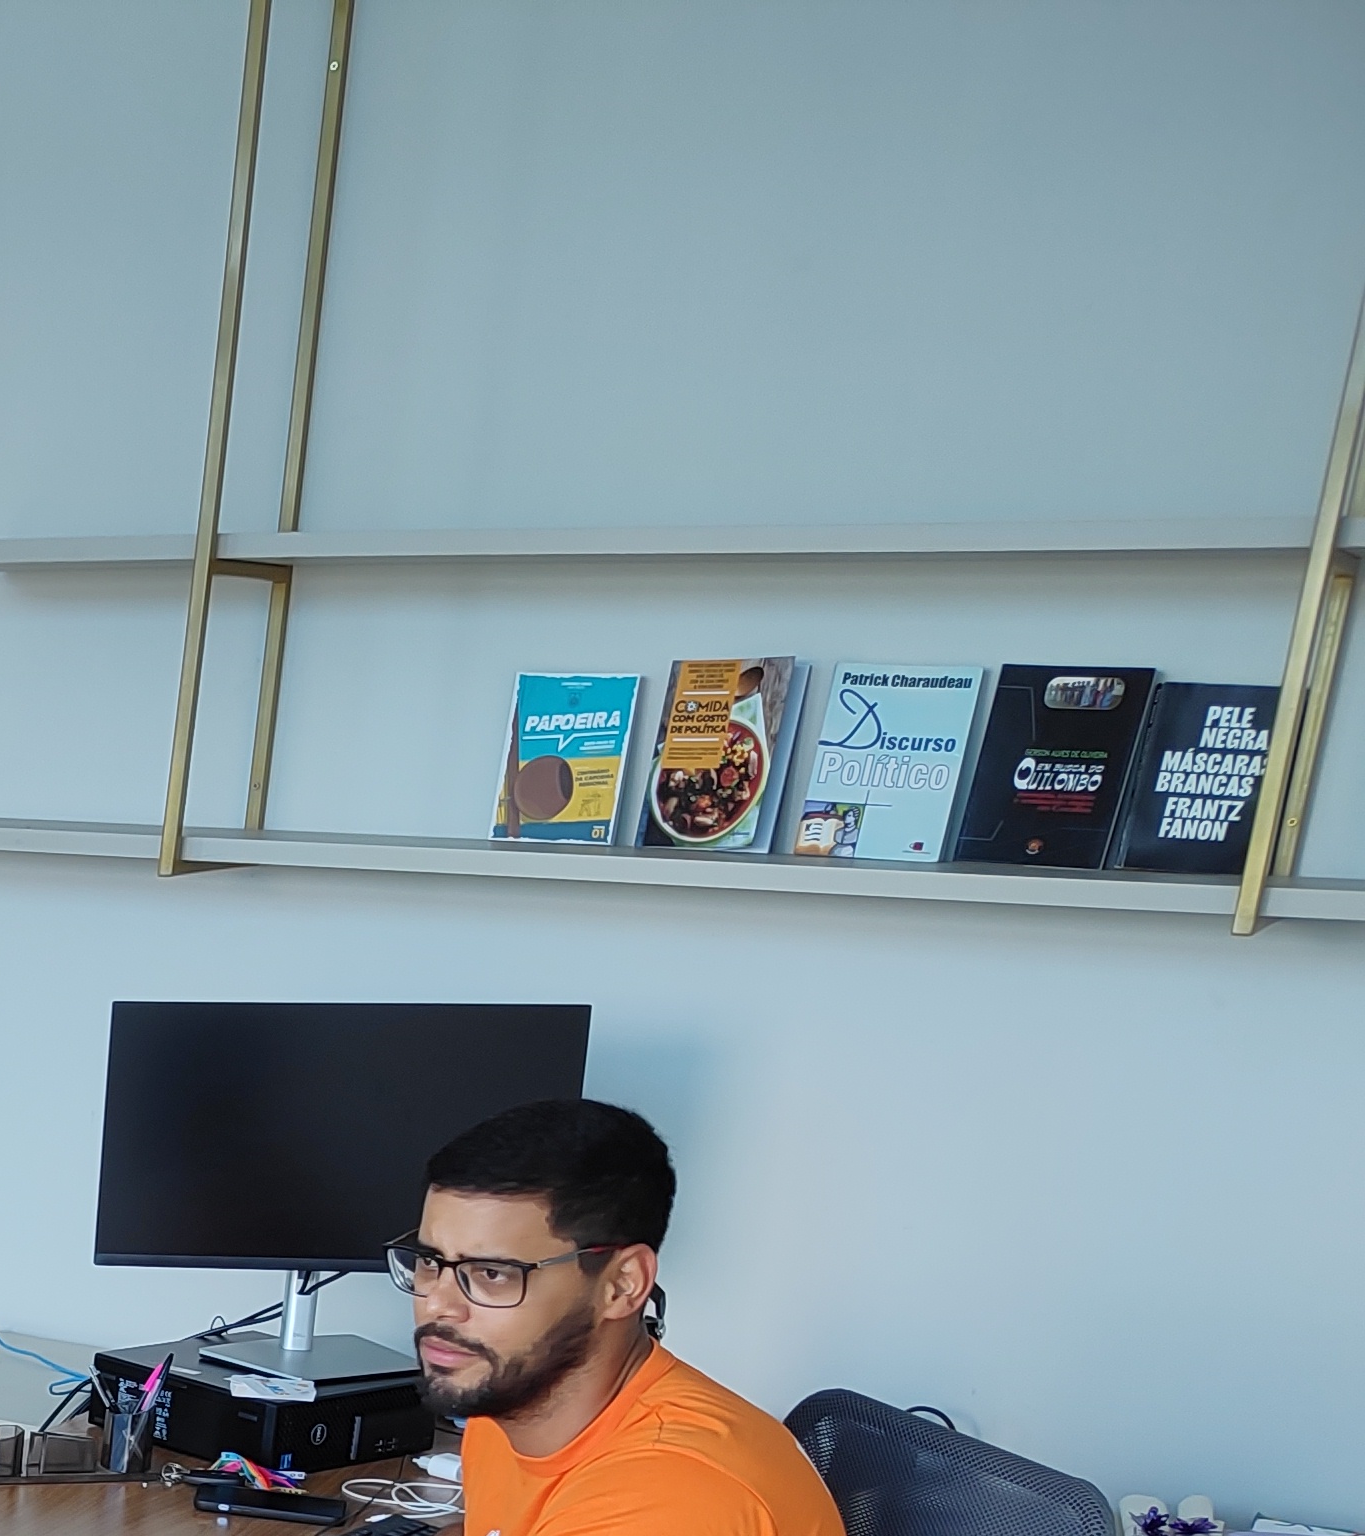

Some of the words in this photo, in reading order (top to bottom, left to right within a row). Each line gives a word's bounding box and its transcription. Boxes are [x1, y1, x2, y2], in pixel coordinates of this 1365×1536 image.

[842, 672, 889, 687] Patrick
[891, 674, 973, 689] Charaudeau
[524, 710, 621, 732] PAPOEIRA
[672, 714, 695, 723] COM
[696, 713, 729, 722] GOSTO
[684, 723, 726, 734] POLÍTICA
[818, 688, 957, 753] Discurso
[1204, 706, 1257, 728] PELE
[1199, 727, 1269, 751] NEGRA
[817, 751, 950, 791] Político
[1013, 757, 1103, 792] QUILOMBO
[1154, 771, 1255, 798] BRANCAS
[1163, 796, 1246, 822] FRANTZ
[591, 827, 605, 839] 01
[1157, 817, 1230, 842] FANON
